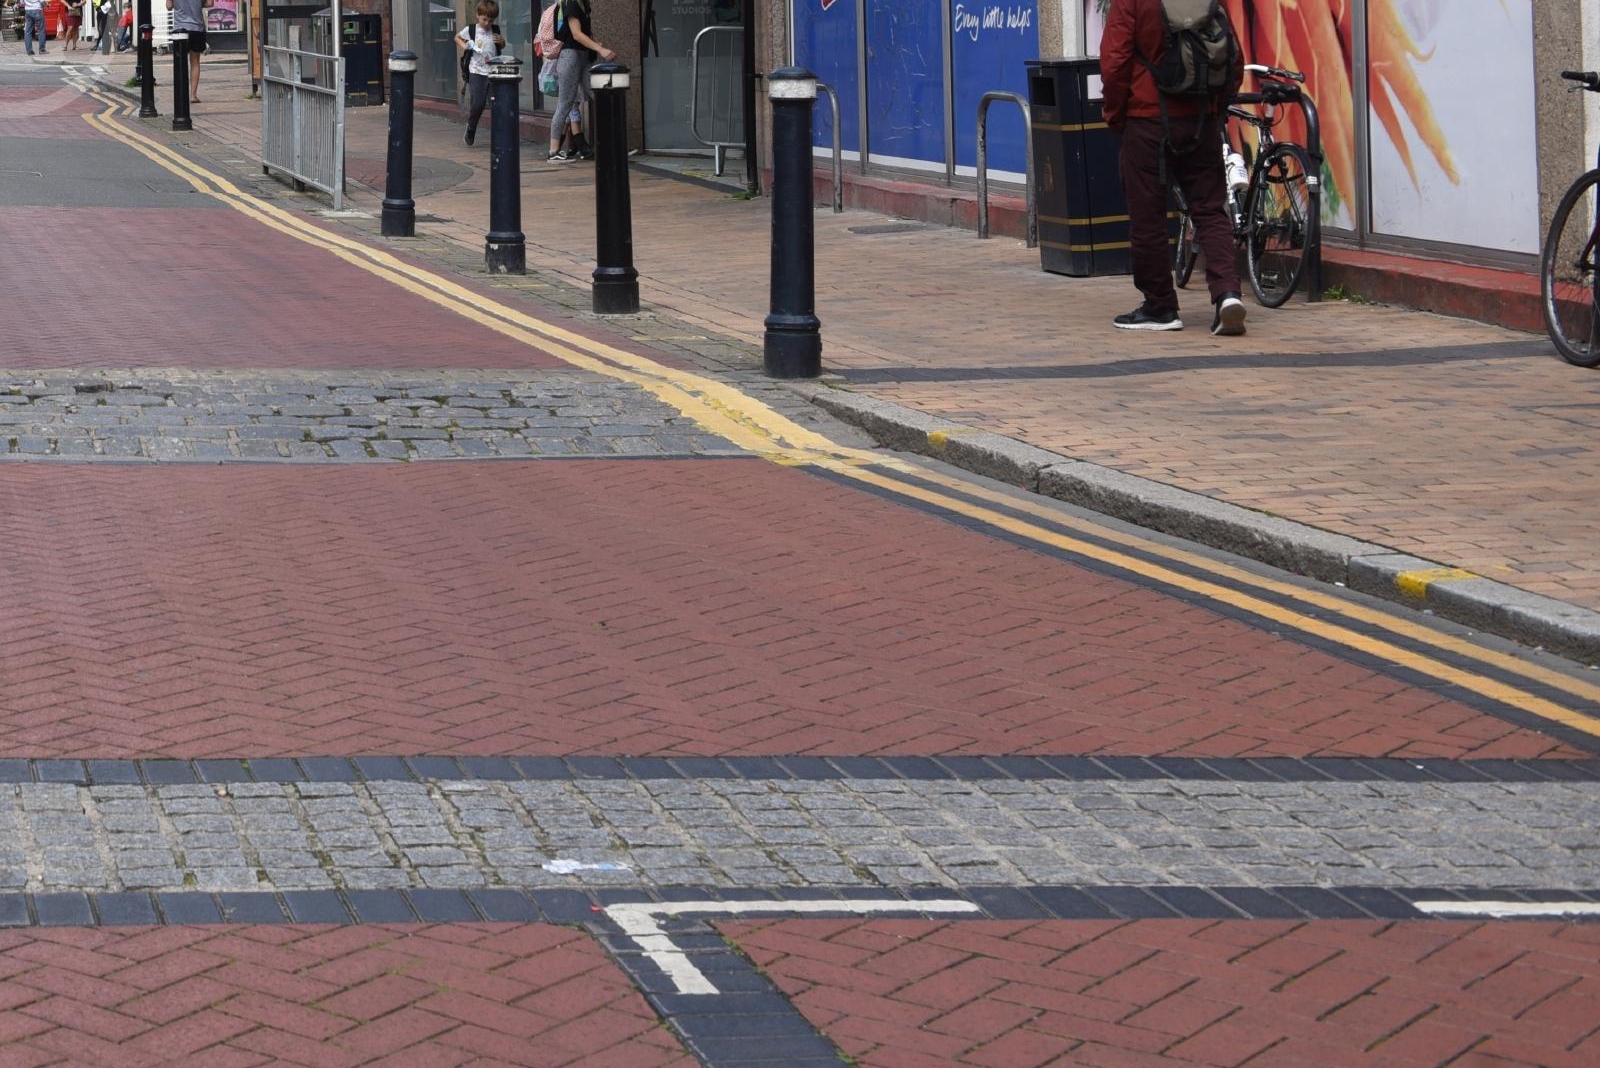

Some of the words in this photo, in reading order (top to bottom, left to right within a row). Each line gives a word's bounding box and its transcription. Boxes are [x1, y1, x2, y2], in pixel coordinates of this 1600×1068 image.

[671, 7, 712, 16] STUDIOS
[954, 3, 979, 42] Every
[983, 5, 1003, 29] little
[1006, 5, 1032, 36] helps
